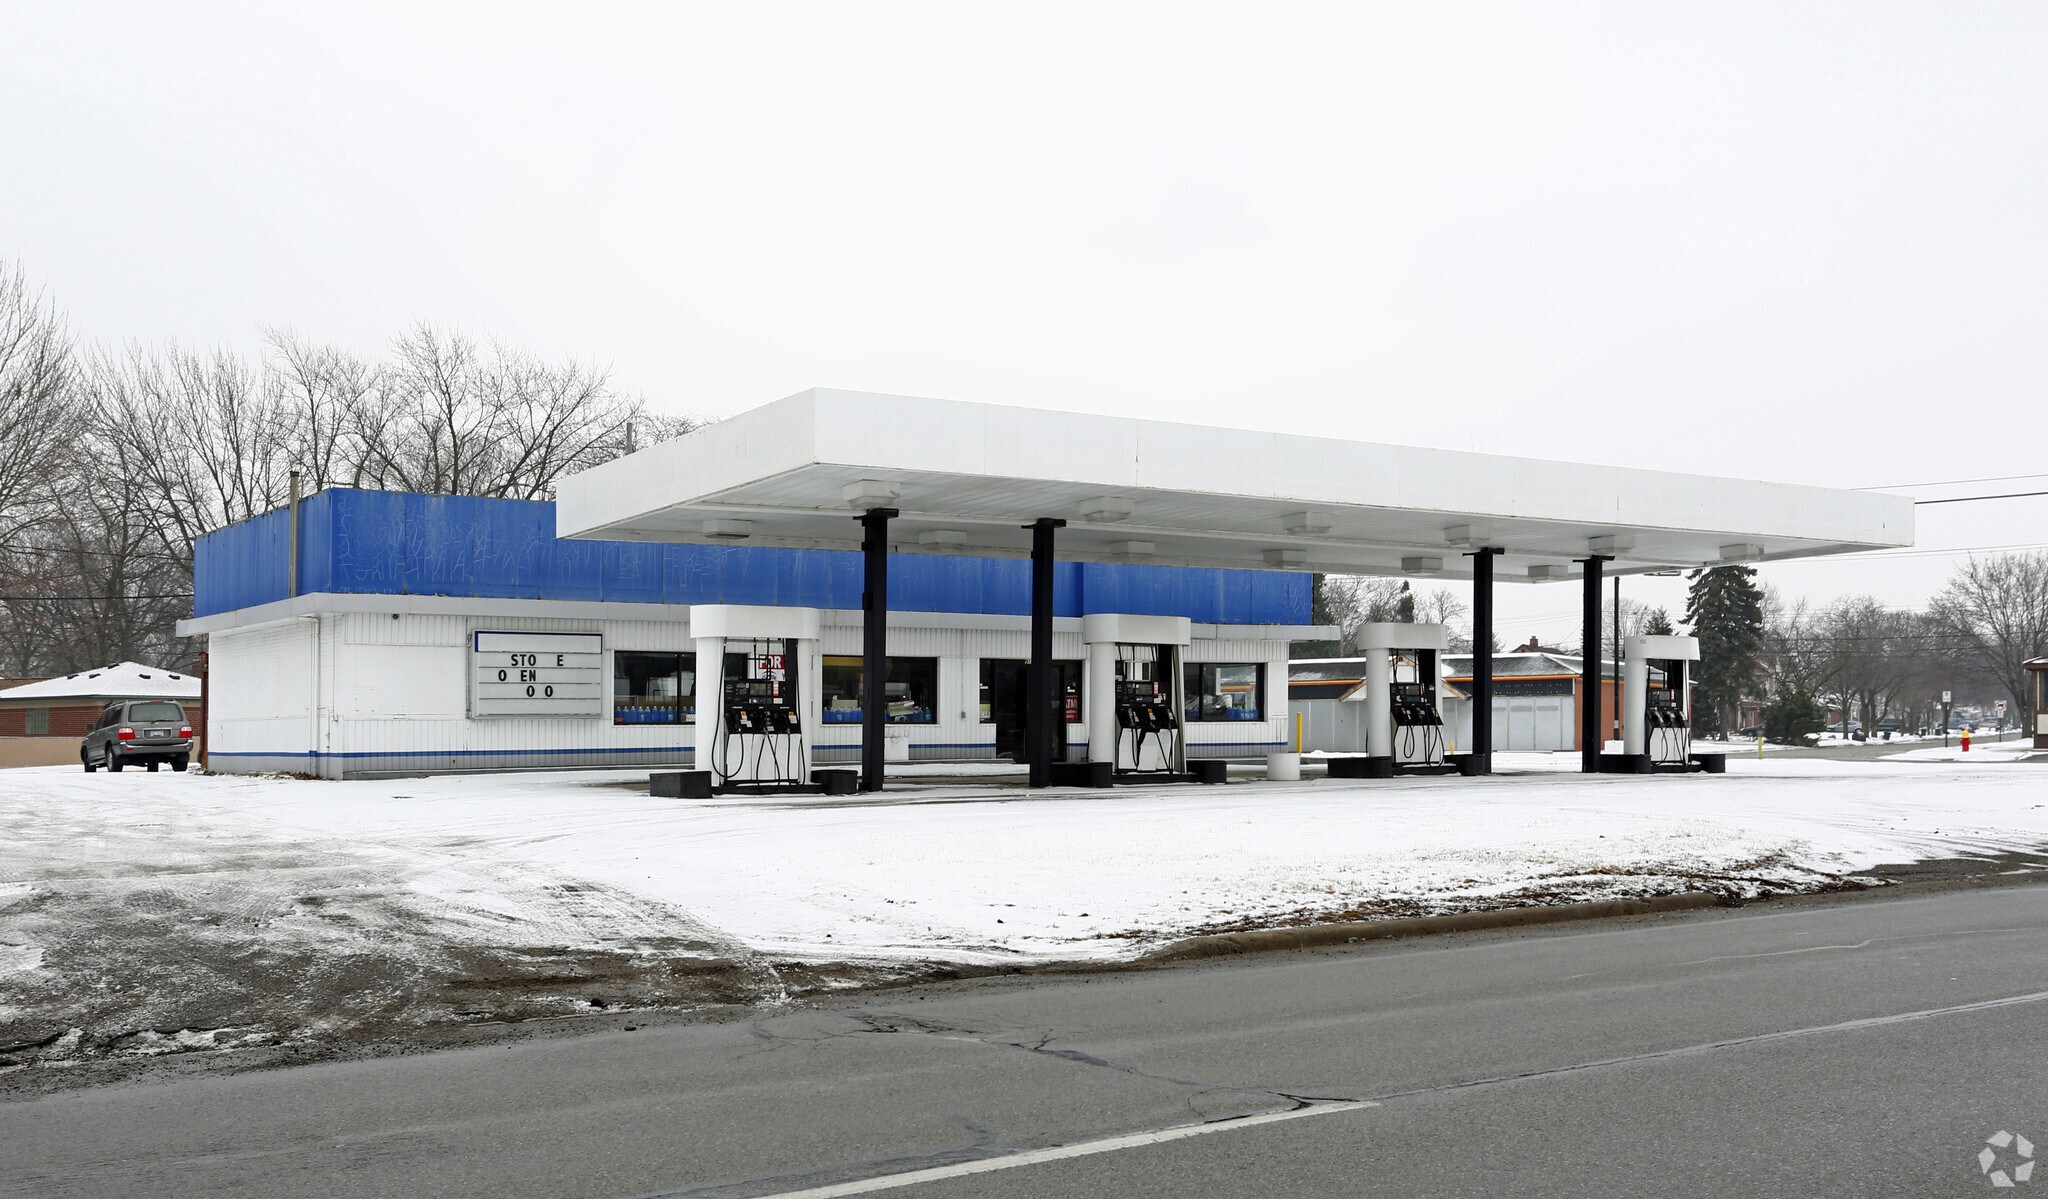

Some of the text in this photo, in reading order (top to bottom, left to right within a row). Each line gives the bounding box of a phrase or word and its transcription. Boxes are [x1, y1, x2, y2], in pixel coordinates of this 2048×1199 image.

[511, 654, 564, 667] STO E
[520, 670, 537, 682] EN
